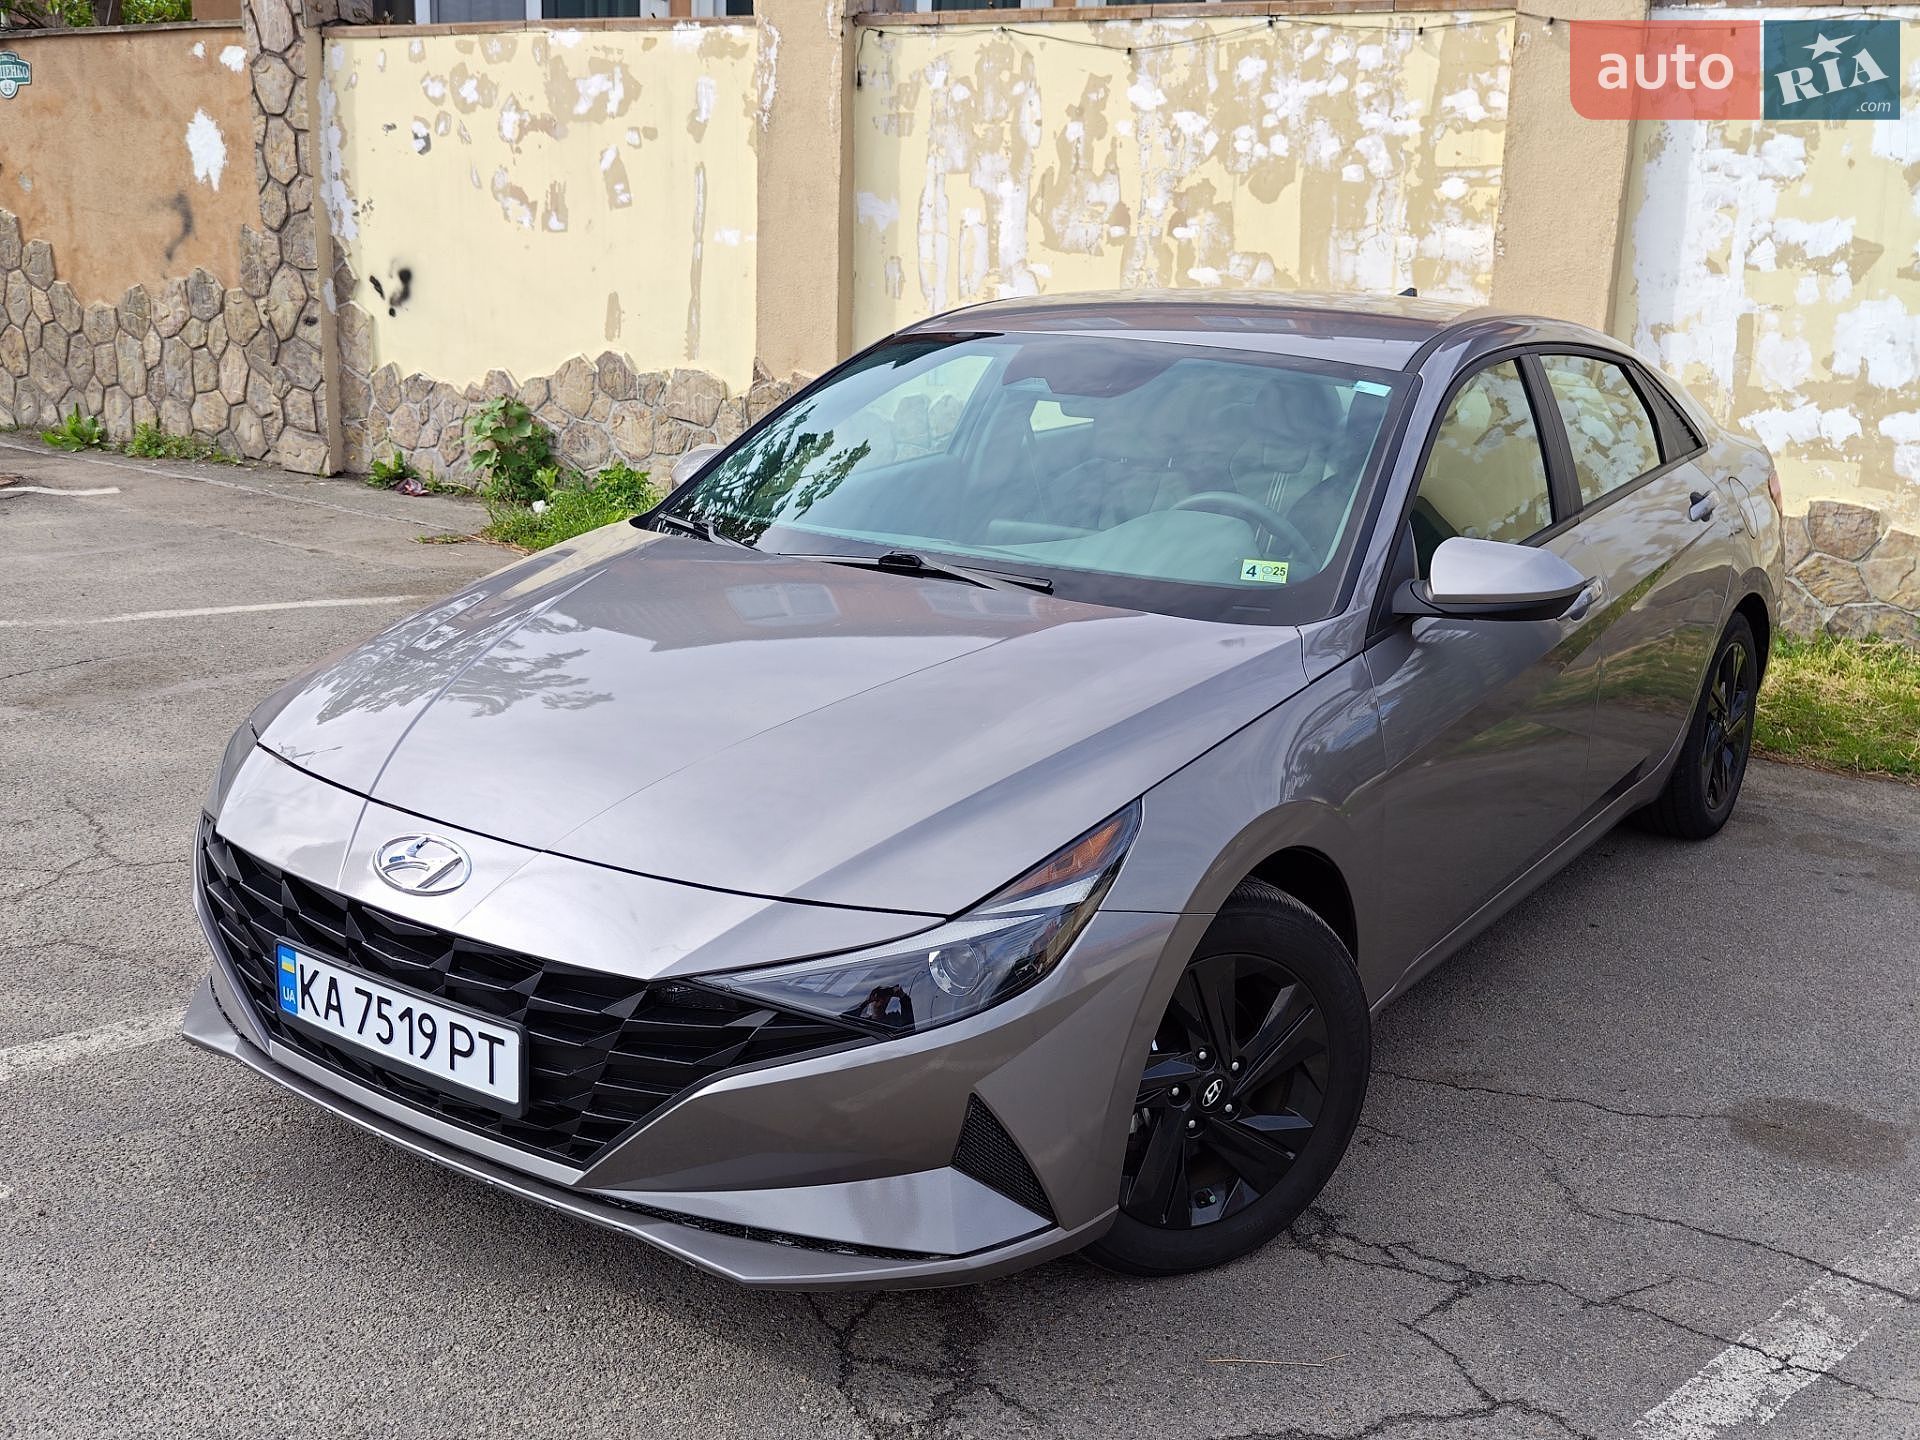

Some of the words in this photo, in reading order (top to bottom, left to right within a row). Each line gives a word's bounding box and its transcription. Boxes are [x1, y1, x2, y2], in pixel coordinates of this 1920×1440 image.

[1245, 565, 1257, 577] 4
[1272, 566, 1286, 577] 25
[282, 985, 297, 1006] UA
[300, 963, 345, 1028] KA
[354, 986, 438, 1060] 7519
[449, 1021, 505, 1086] PT
